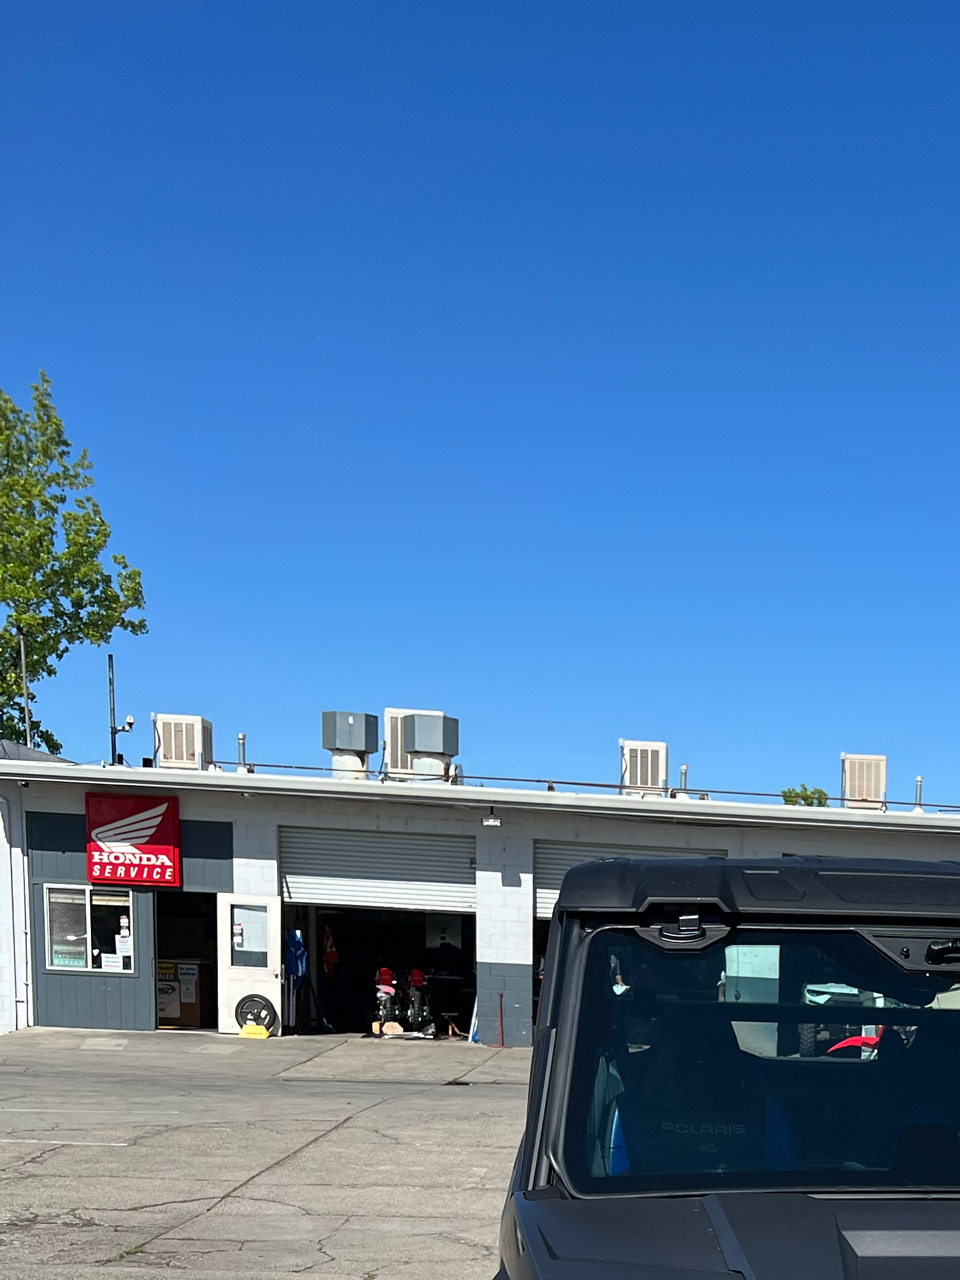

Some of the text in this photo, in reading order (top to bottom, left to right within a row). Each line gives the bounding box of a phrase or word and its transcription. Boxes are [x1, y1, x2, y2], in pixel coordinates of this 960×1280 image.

[92, 852, 173, 866] HONDA
[92, 865, 173, 879] SERVICE
[661, 1121, 746, 1135] POLARIS
